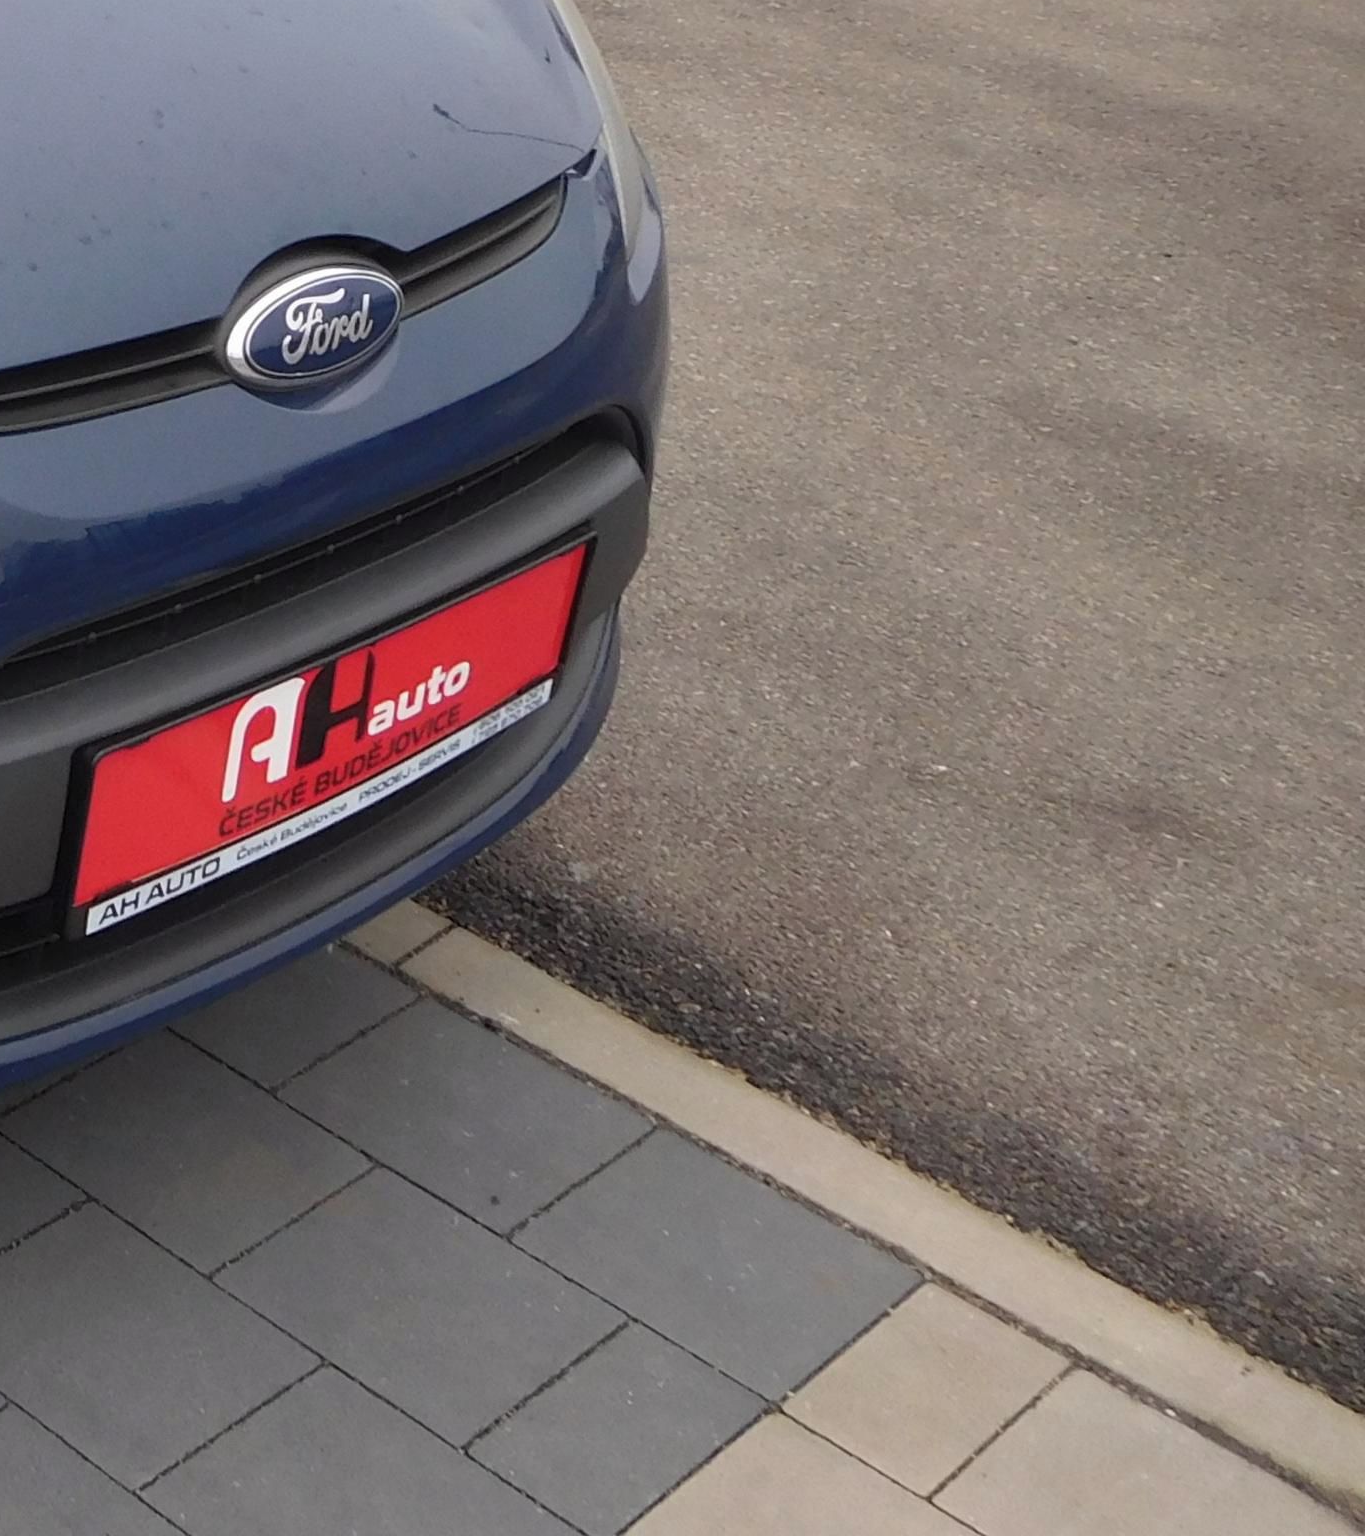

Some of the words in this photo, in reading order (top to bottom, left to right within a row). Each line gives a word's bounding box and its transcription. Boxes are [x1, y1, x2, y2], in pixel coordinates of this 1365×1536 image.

[282, 288, 373, 364] Ford
[218, 777, 309, 837] ČESKÉ
[312, 703, 462, 796] BUDĚJOVICE
[98, 891, 141, 925] AH
[145, 857, 221, 905] AUTO
